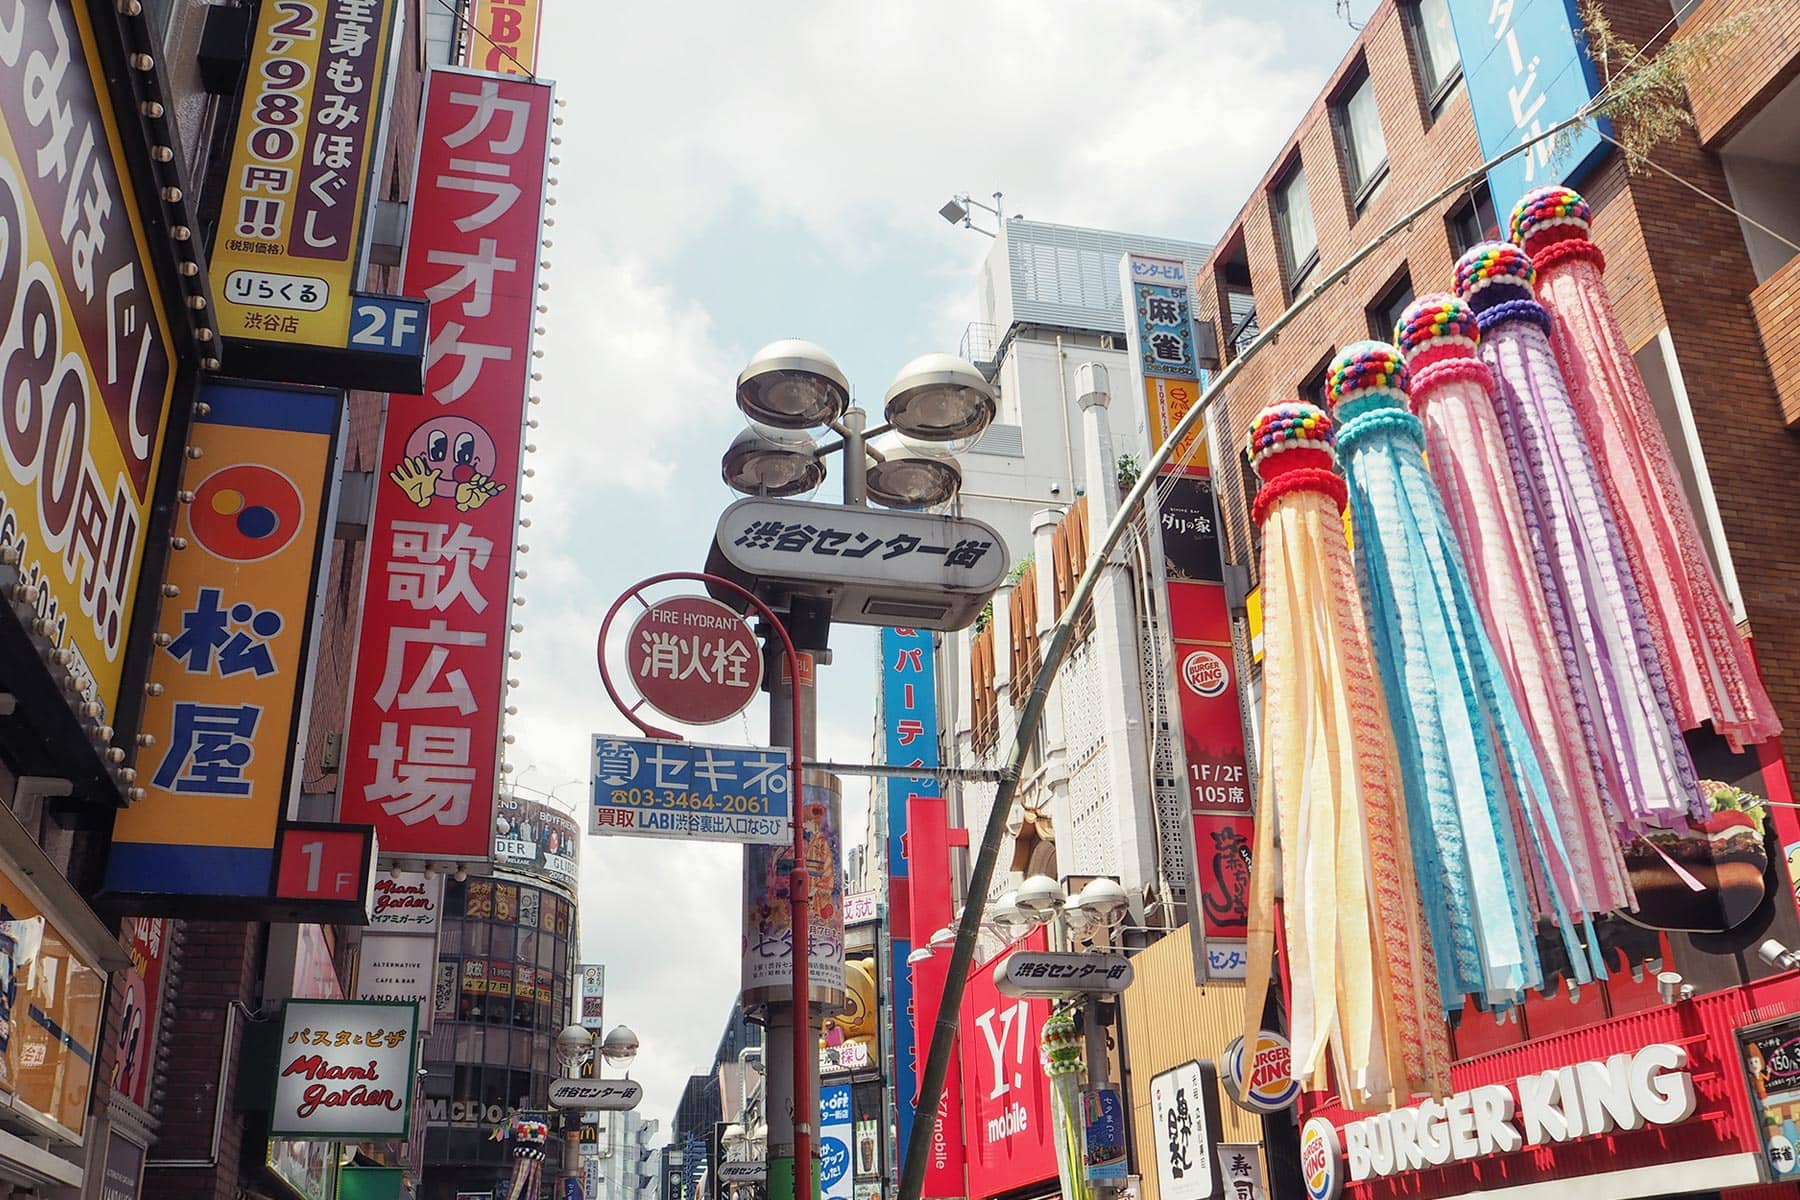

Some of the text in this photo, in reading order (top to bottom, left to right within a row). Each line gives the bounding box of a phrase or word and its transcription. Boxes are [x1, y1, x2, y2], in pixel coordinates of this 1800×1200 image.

[484, 0, 526, 74] BC
[224, 239, 286, 256] (税別価格)
[426, 81, 532, 405] カラオケ
[1132, 261, 1184, 280] センタービル
[235, 277, 318, 304] りらくる
[244, 311, 300, 335] 渋谷店
[352, 305, 419, 348] 2F
[1148, 297, 1183, 362] 麻雀
[1158, 384, 1170, 441] TORIKIZO
[1161, 513, 1211, 535] ダリの家
[734, 520, 993, 570] 渋谷センター街
[652, 608, 739, 632] FIRE HYDRANT
[640, 629, 752, 689] 消火栓
[1189, 661, 1219, 675] BURGER
[364, 519, 495, 827] 歌広場
[1192, 668, 1222, 686] KING
[152, 587, 285, 798] 松屋
[645, 744, 787, 796] セキネ
[628, 788, 770, 814] 03-3464-2061
[598, 808, 635, 828] 買取
[300, 841, 353, 892] 1F
[374, 879, 426, 896] Miami
[1014, 962, 1127, 980] 渋谷センター街
[361, 993, 427, 1003] VANDALISM
[288, 1028, 407, 1048] パスタとピザ
[975, 1000, 1029, 1101] Y!
[282, 1055, 379, 1080] Miami
[1252, 1046, 1291, 1068] URGER
[553, 1086, 638, 1099] 渋谷センター街
[988, 1101, 1028, 1145] mobile
[1345, 1043, 1697, 1182] BURGER KING
[1305, 1149, 1327, 1184] KING
